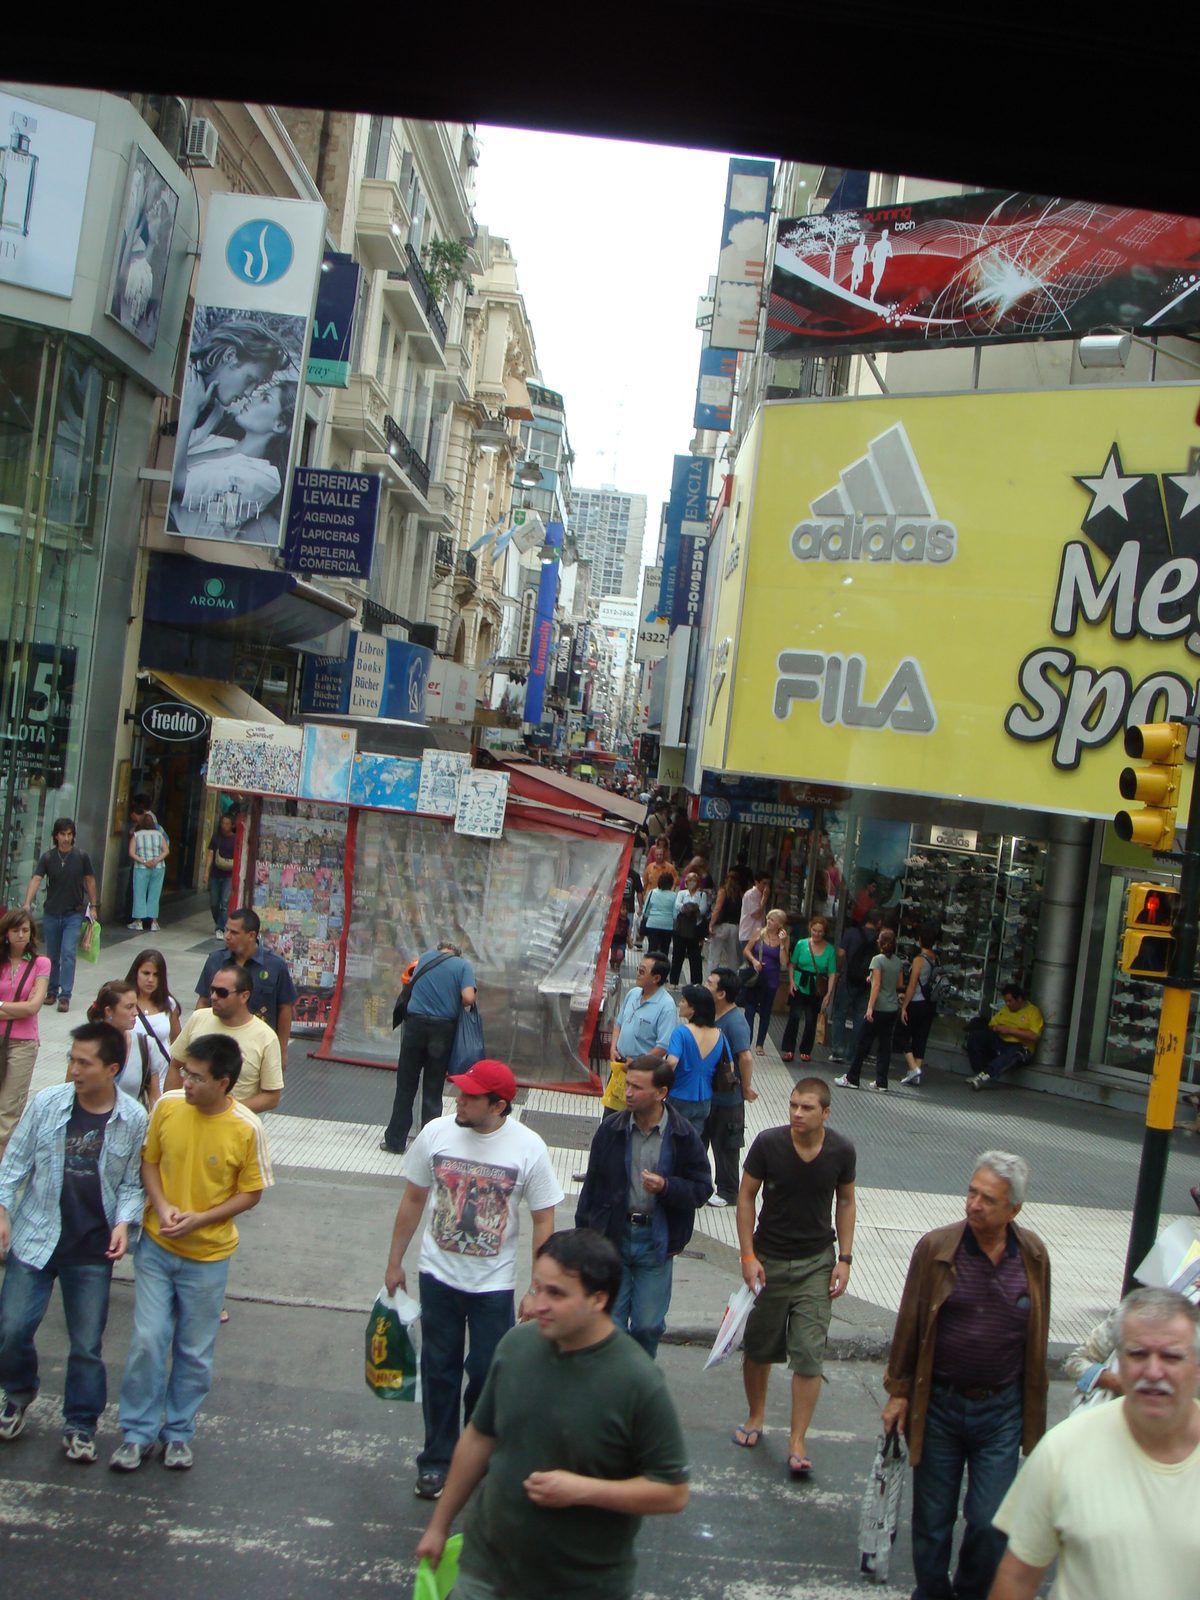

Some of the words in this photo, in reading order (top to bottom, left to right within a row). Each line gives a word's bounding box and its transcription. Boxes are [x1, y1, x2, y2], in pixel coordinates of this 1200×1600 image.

[297, 472, 370, 492] LIBRERIAS
[303, 490, 360, 508] LEVALLE
[304, 512, 355, 526] AGENDAS
[301, 527, 360, 544] LAPICERAS
[792, 513, 957, 564] adidas
[300, 545, 356, 560] PAPELERIA
[299, 557, 361, 574] COMERCIAL
[190, 595, 236, 610] AROMA
[1051, 539, 1200, 659] Me
[359, 641, 384, 656] Libros
[356, 659, 382, 673] Books
[354, 676, 380, 691] Bücher
[773, 648, 937, 734] FILA
[352, 693, 378, 709] Livres
[751, 801, 800, 816] CABINAS
[739, 812, 810, 829] TELEFONICAS
